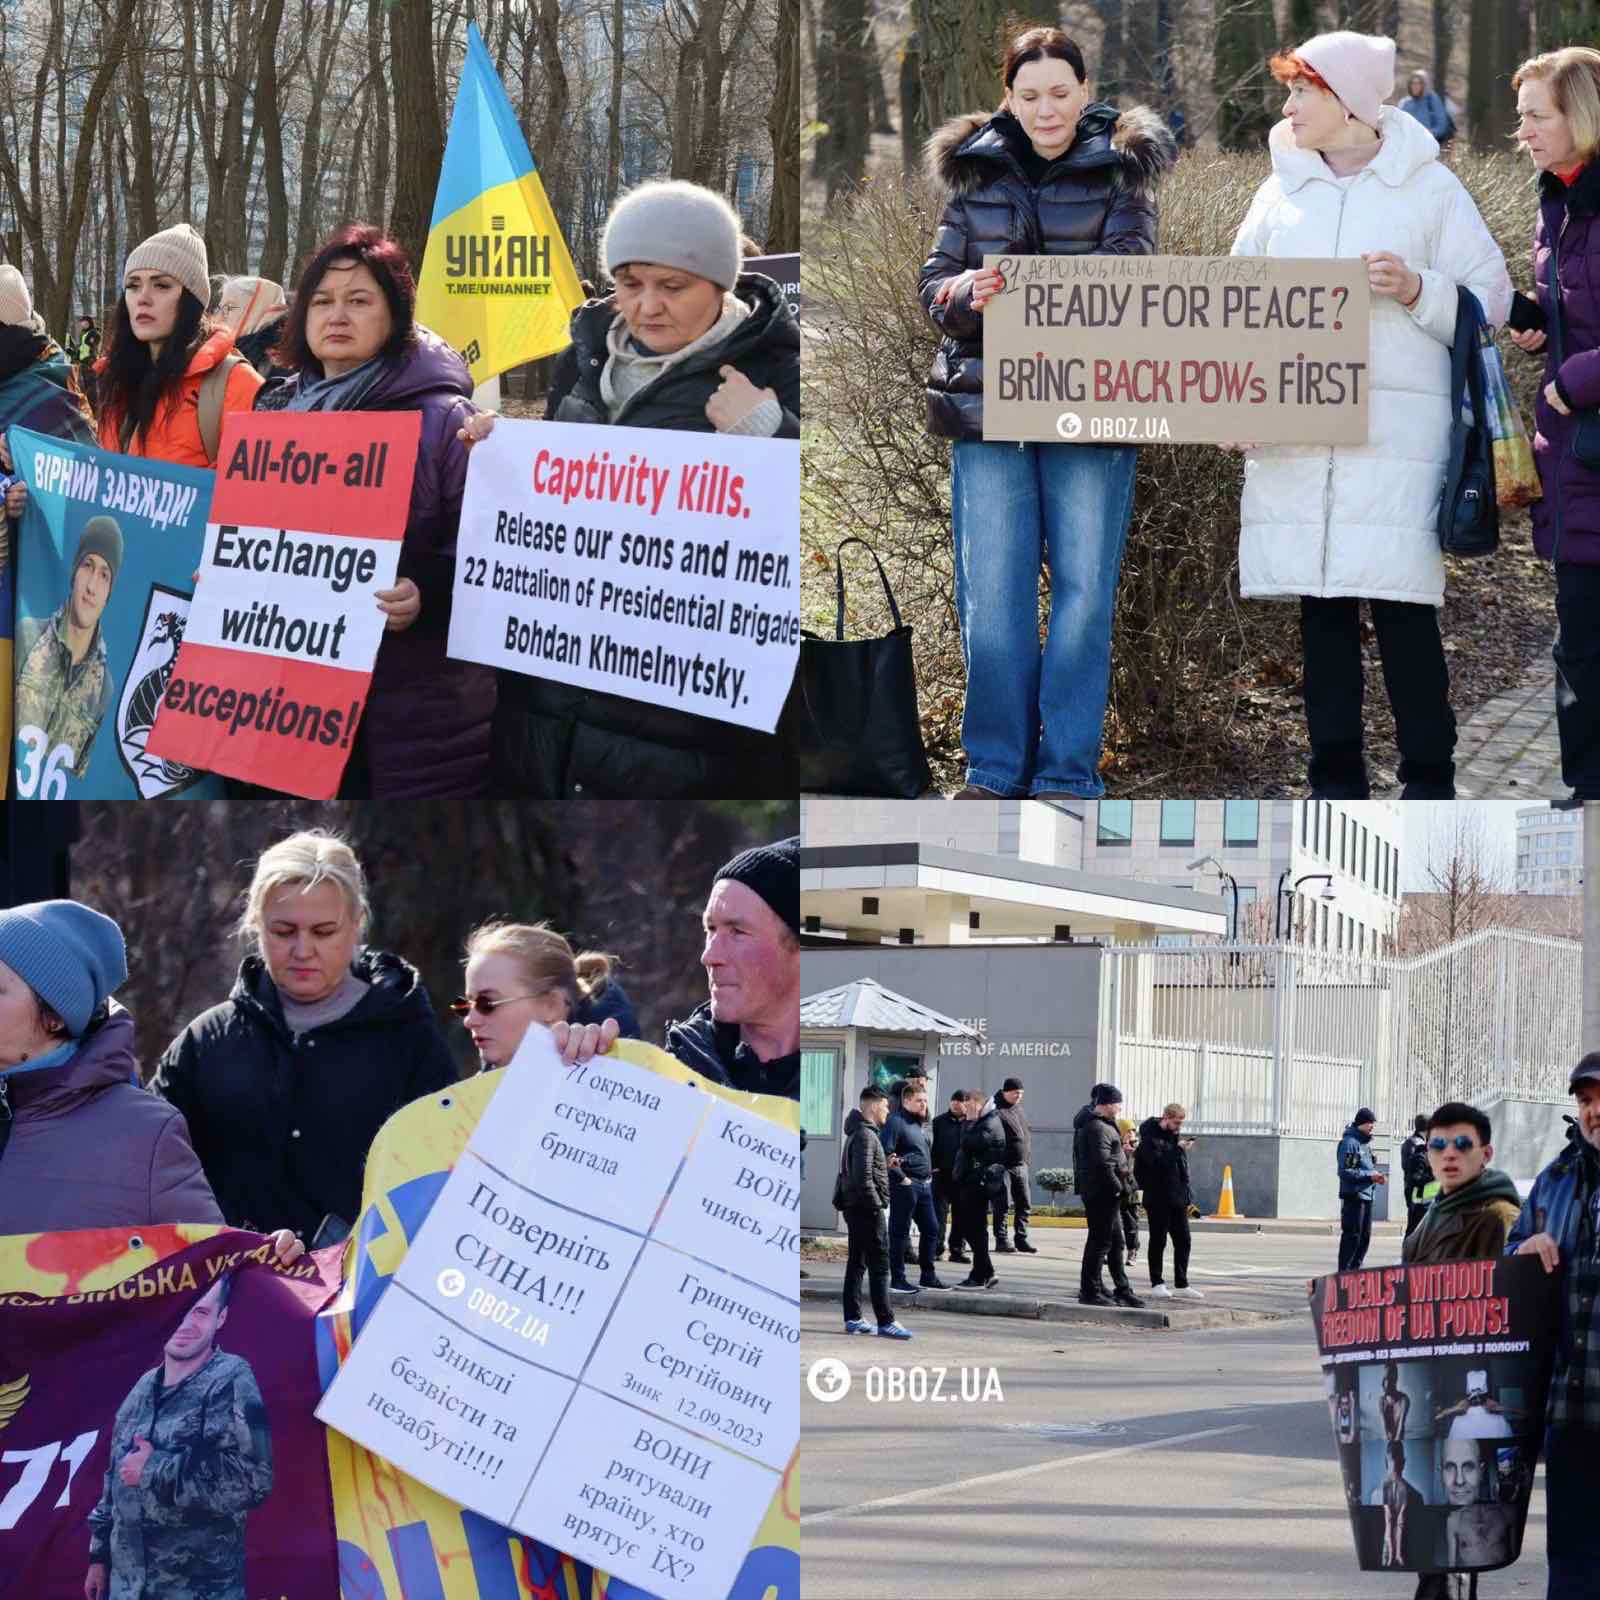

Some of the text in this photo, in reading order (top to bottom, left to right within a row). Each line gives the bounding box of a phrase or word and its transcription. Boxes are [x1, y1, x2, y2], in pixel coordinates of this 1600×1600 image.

[446, 216, 550, 277] УНІАН
[446, 283, 550, 295] T.ME/UNIANNET
[1024, 284, 1349, 331] READY FOR PEACE?
[1093, 359, 1175, 402] BACK
[1180, 360, 1267, 404] POWs
[34, 452, 198, 530] ВІРНИЙ ЗАВЖДИ!
[226, 438, 389, 487] All-for- all
[533, 449, 751, 519] Captivity Kills.
[212, 526, 377, 592] Exchange
[495, 510, 792, 589] Release our sons and men.
[221, 602, 346, 659] without
[463, 557, 800, 647] 22 battalion of Presidential Brigade
[504, 615, 750, 709] Bohdan Khmelnytsky.
[164, 677, 365, 748] exceptions!
[15, 725, 75, 800] 36
[959, 1018, 988, 1031] THE
[976, 1042, 996, 1056] OF
[1000, 1042, 1071, 1056] AMERICA
[555, 1103, 637, 1142] єгерська
[590, 1075, 661, 1111] окрема
[541, 1132, 618, 1175] бригада
[720, 1120, 796, 1169] Кожен
[467, 1182, 610, 1270] Поверніть
[701, 1197, 762, 1236] чиясь
[455, 1233, 585, 1315] СИНА!!!
[1409, 1260, 1497, 1303] WITHOUT
[678, 1273, 800, 1344] Гринченко
[1323, 1296, 1510, 1348] FREEDOM OF UA POWS!
[431, 1335, 518, 1396] Зниклі
[686, 1318, 763, 1370] Сергій
[390, 1355, 519, 1444] безвісти та
[642, 1341, 773, 1416] Сергійович
[367, 1390, 505, 1481] незабуті!!!!
[620, 1372, 764, 1449] Зник 12.09.2023
[632, 1428, 713, 1481] ВОНИ
[579, 1482, 705, 1553] країну, хто
[605, 1455, 713, 1520] рятували
[563, 1512, 641, 1561] врятує
[650, 1546, 696, 1584] ЇХ?
